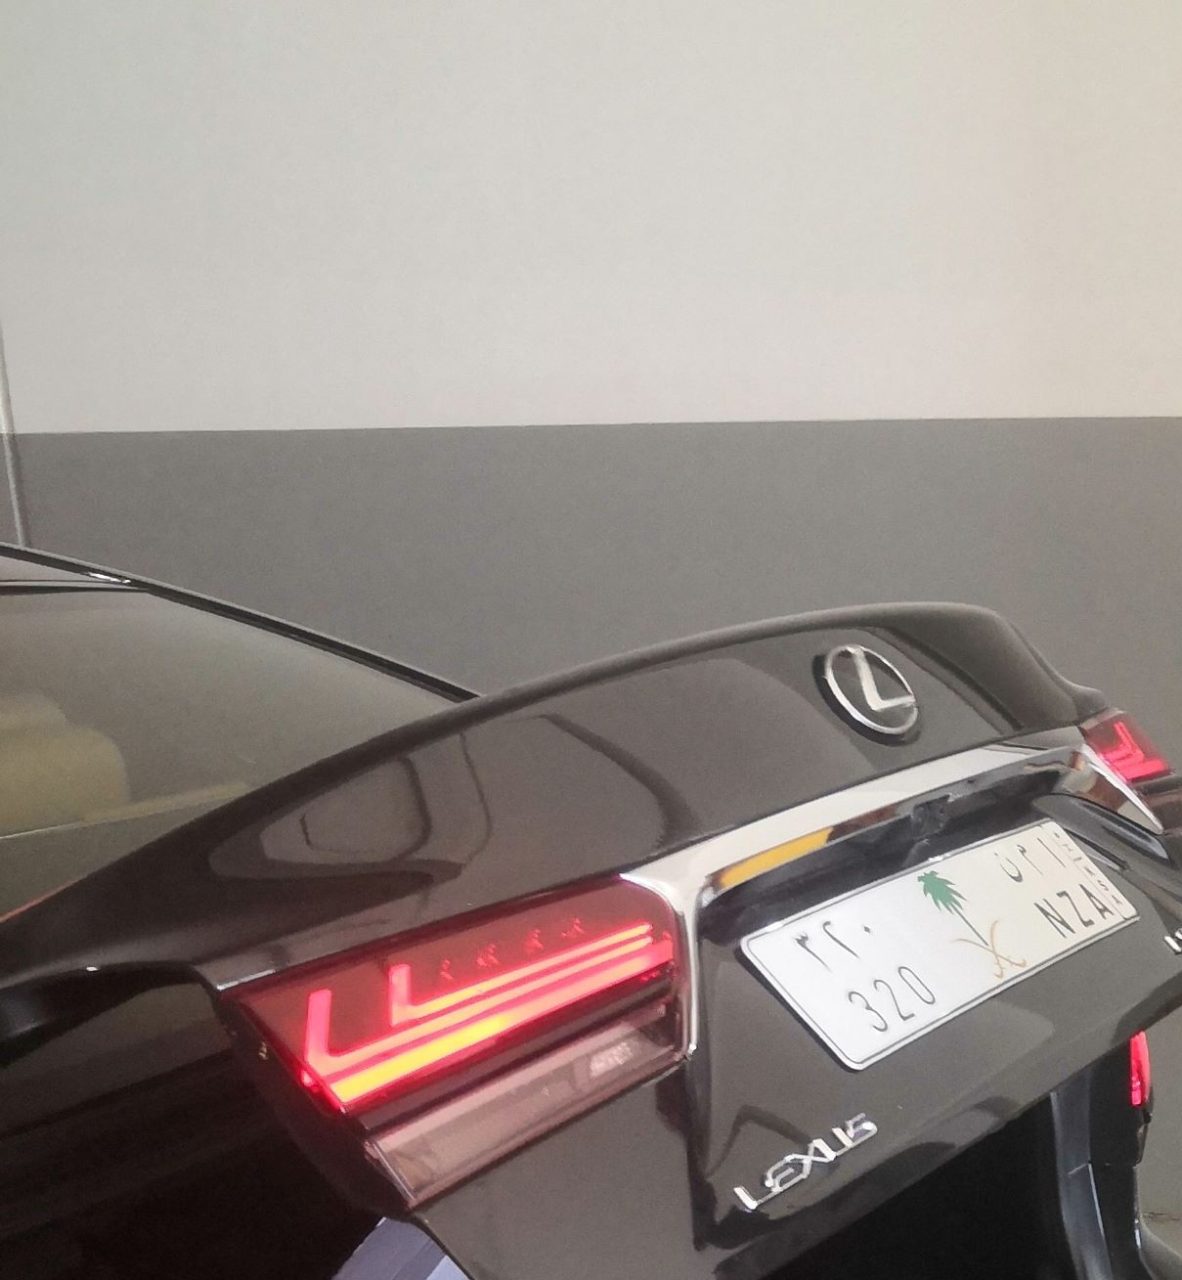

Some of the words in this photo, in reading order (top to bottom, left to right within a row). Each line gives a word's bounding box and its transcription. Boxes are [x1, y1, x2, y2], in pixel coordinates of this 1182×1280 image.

[1033, 883, 1115, 939] NZA
[848, 966, 937, 1034] 320
[733, 1113, 878, 1212] LEXUS
